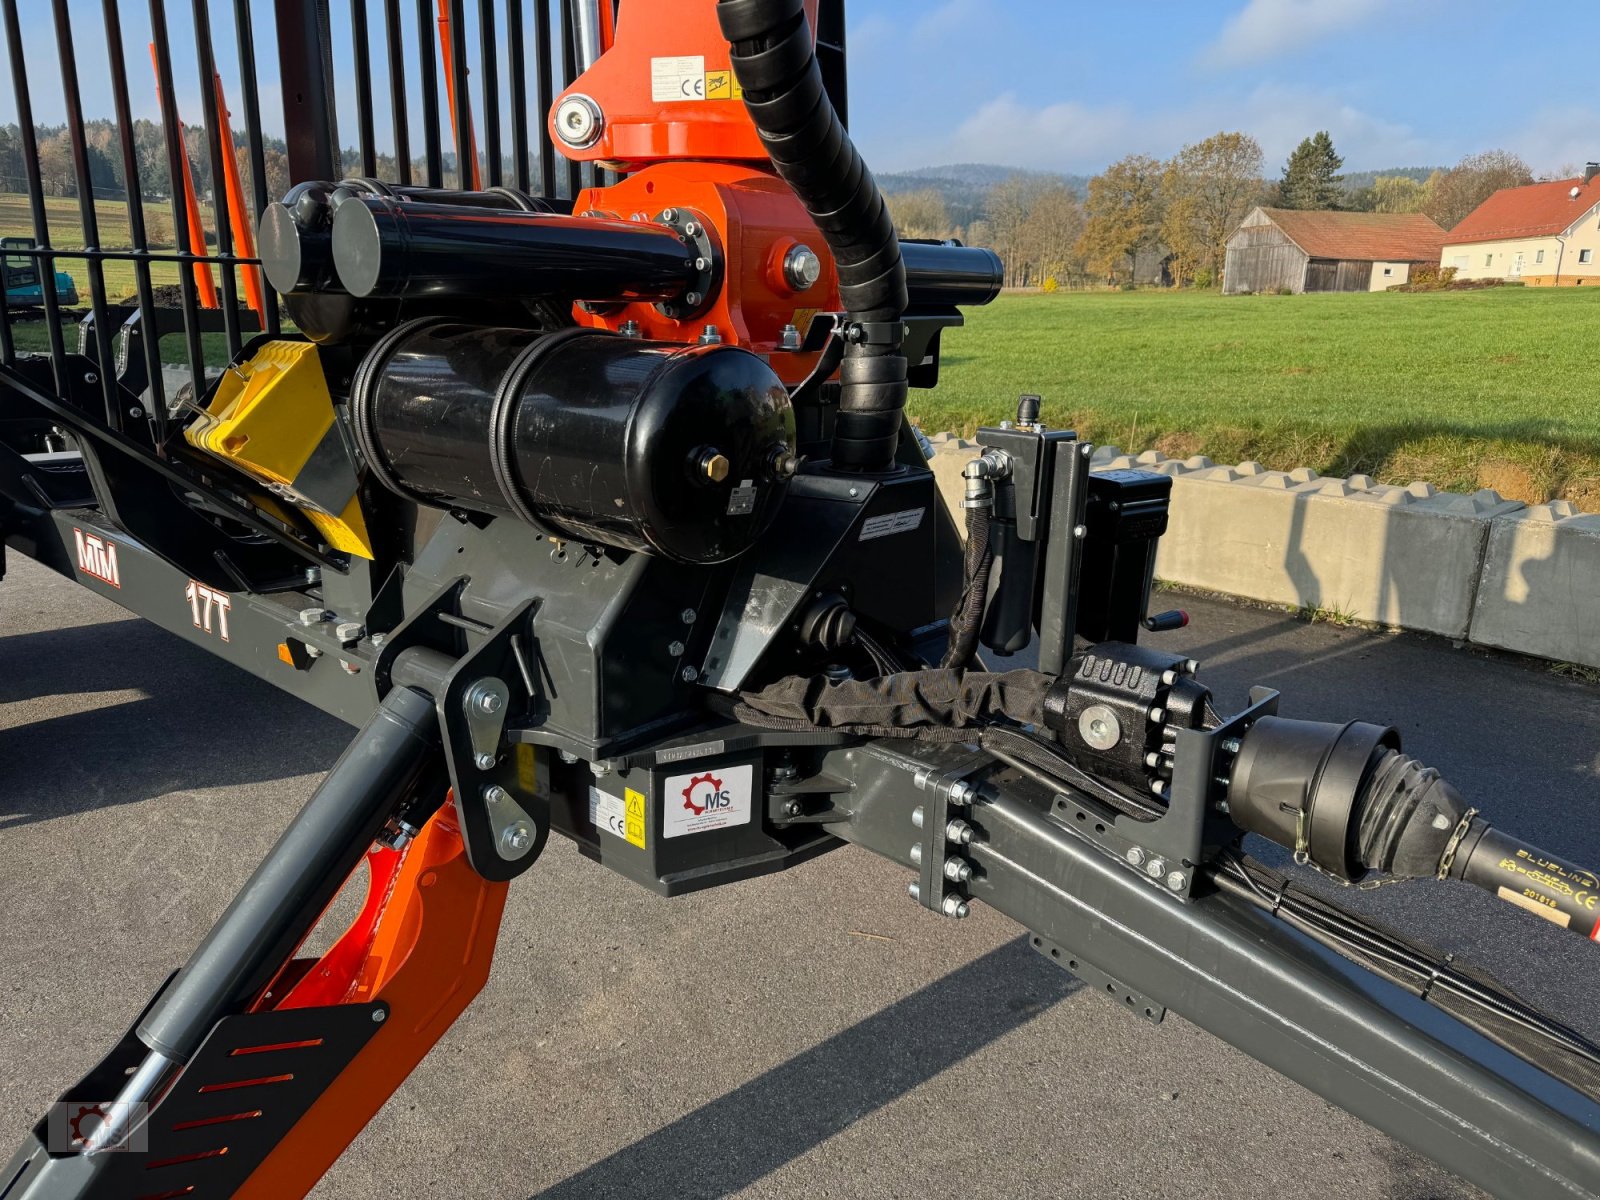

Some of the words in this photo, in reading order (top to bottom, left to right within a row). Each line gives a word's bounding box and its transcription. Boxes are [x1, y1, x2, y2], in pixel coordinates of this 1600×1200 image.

[74, 527, 121, 589] MTM
[185, 578, 232, 643] 17T
[1516, 849, 1593, 888] BLUELINE
